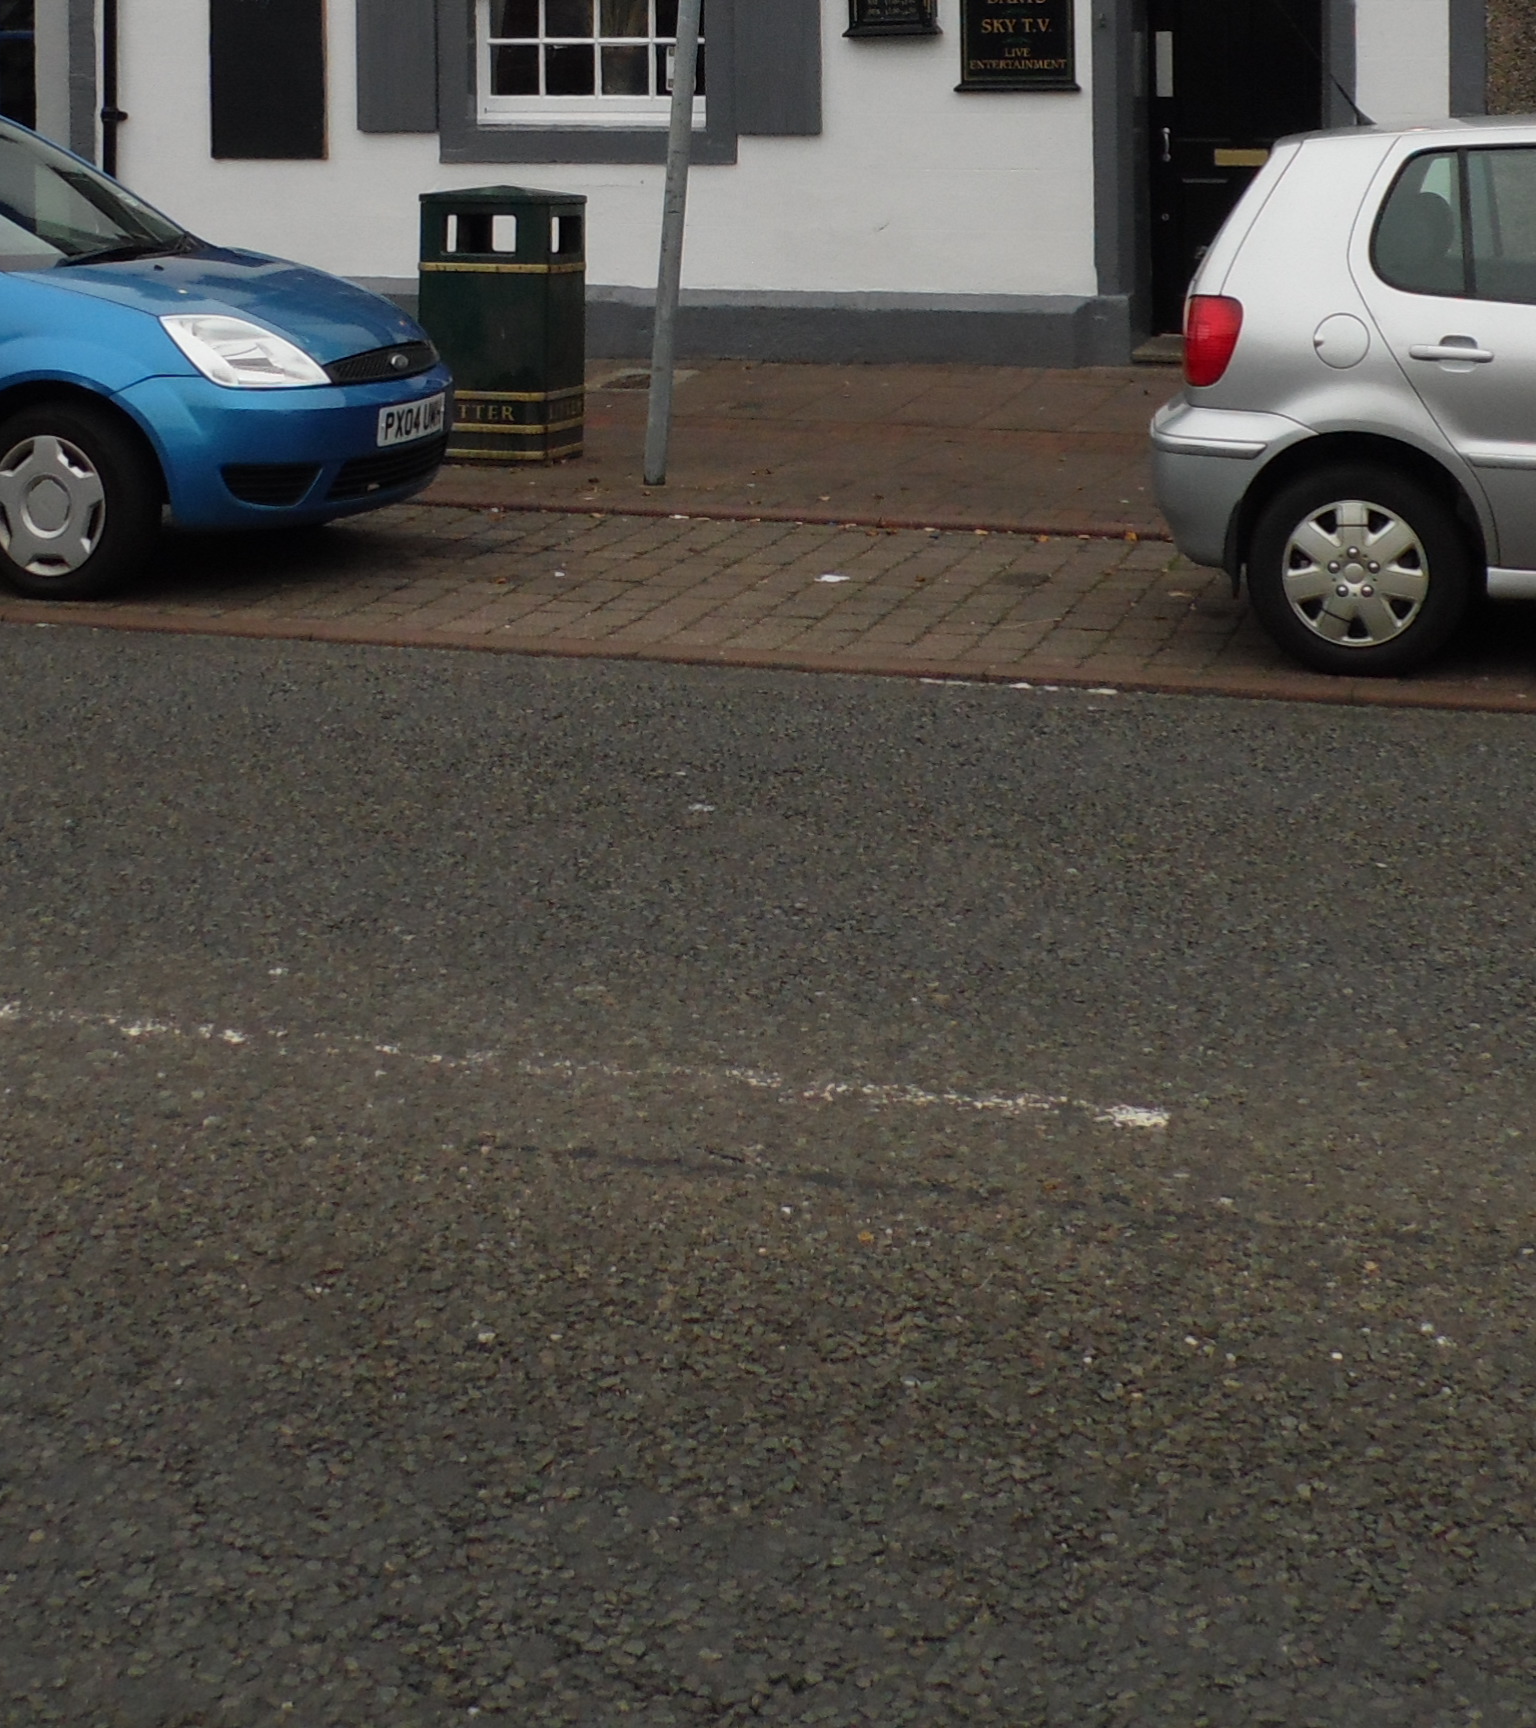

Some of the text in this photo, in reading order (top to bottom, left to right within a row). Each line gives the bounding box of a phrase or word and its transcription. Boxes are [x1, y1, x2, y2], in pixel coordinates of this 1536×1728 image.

[981, 18, 1016, 33] SKY
[1004, 47, 1031, 58] LIVE
[969, 59, 1067, 70] ENTERTAINMENT
[457, 403, 516, 422] TTER
[383, 404, 421, 441] PX04
